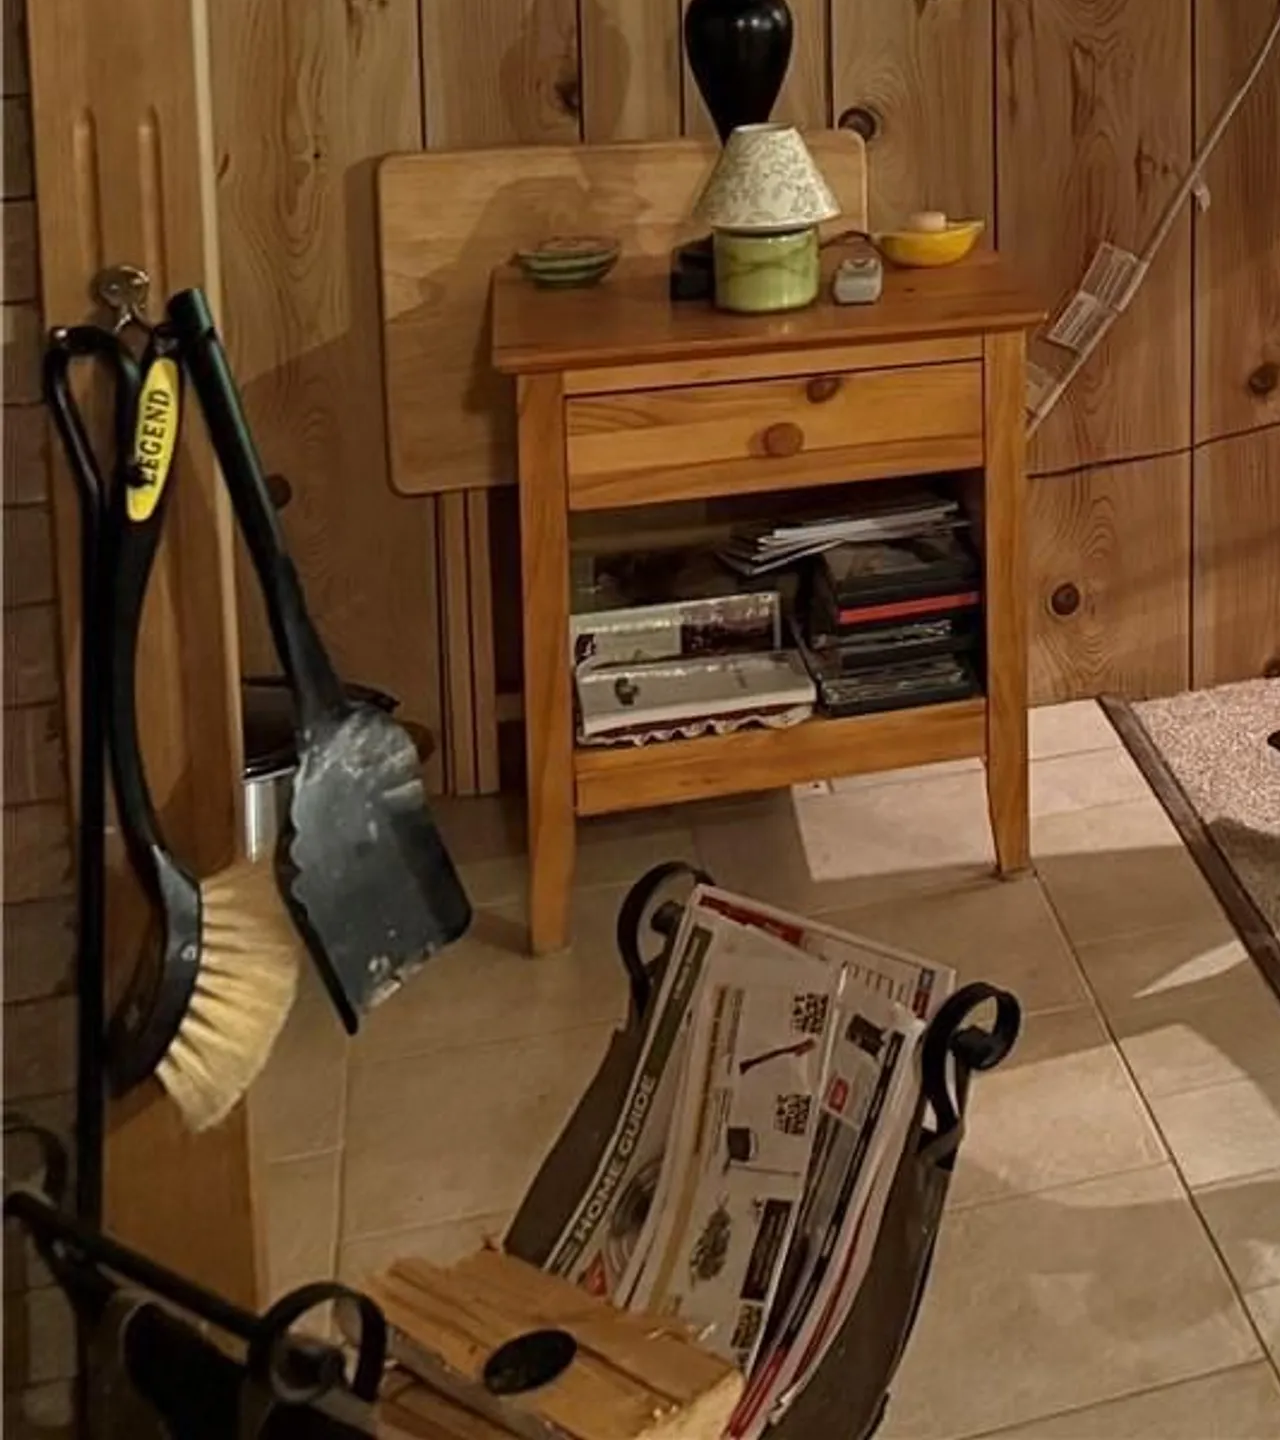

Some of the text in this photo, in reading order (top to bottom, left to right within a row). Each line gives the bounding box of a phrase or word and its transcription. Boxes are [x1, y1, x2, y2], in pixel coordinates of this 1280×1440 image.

[137, 388, 171, 486] LEGEND
[573, 1073, 656, 1242] HOME GUIDE
